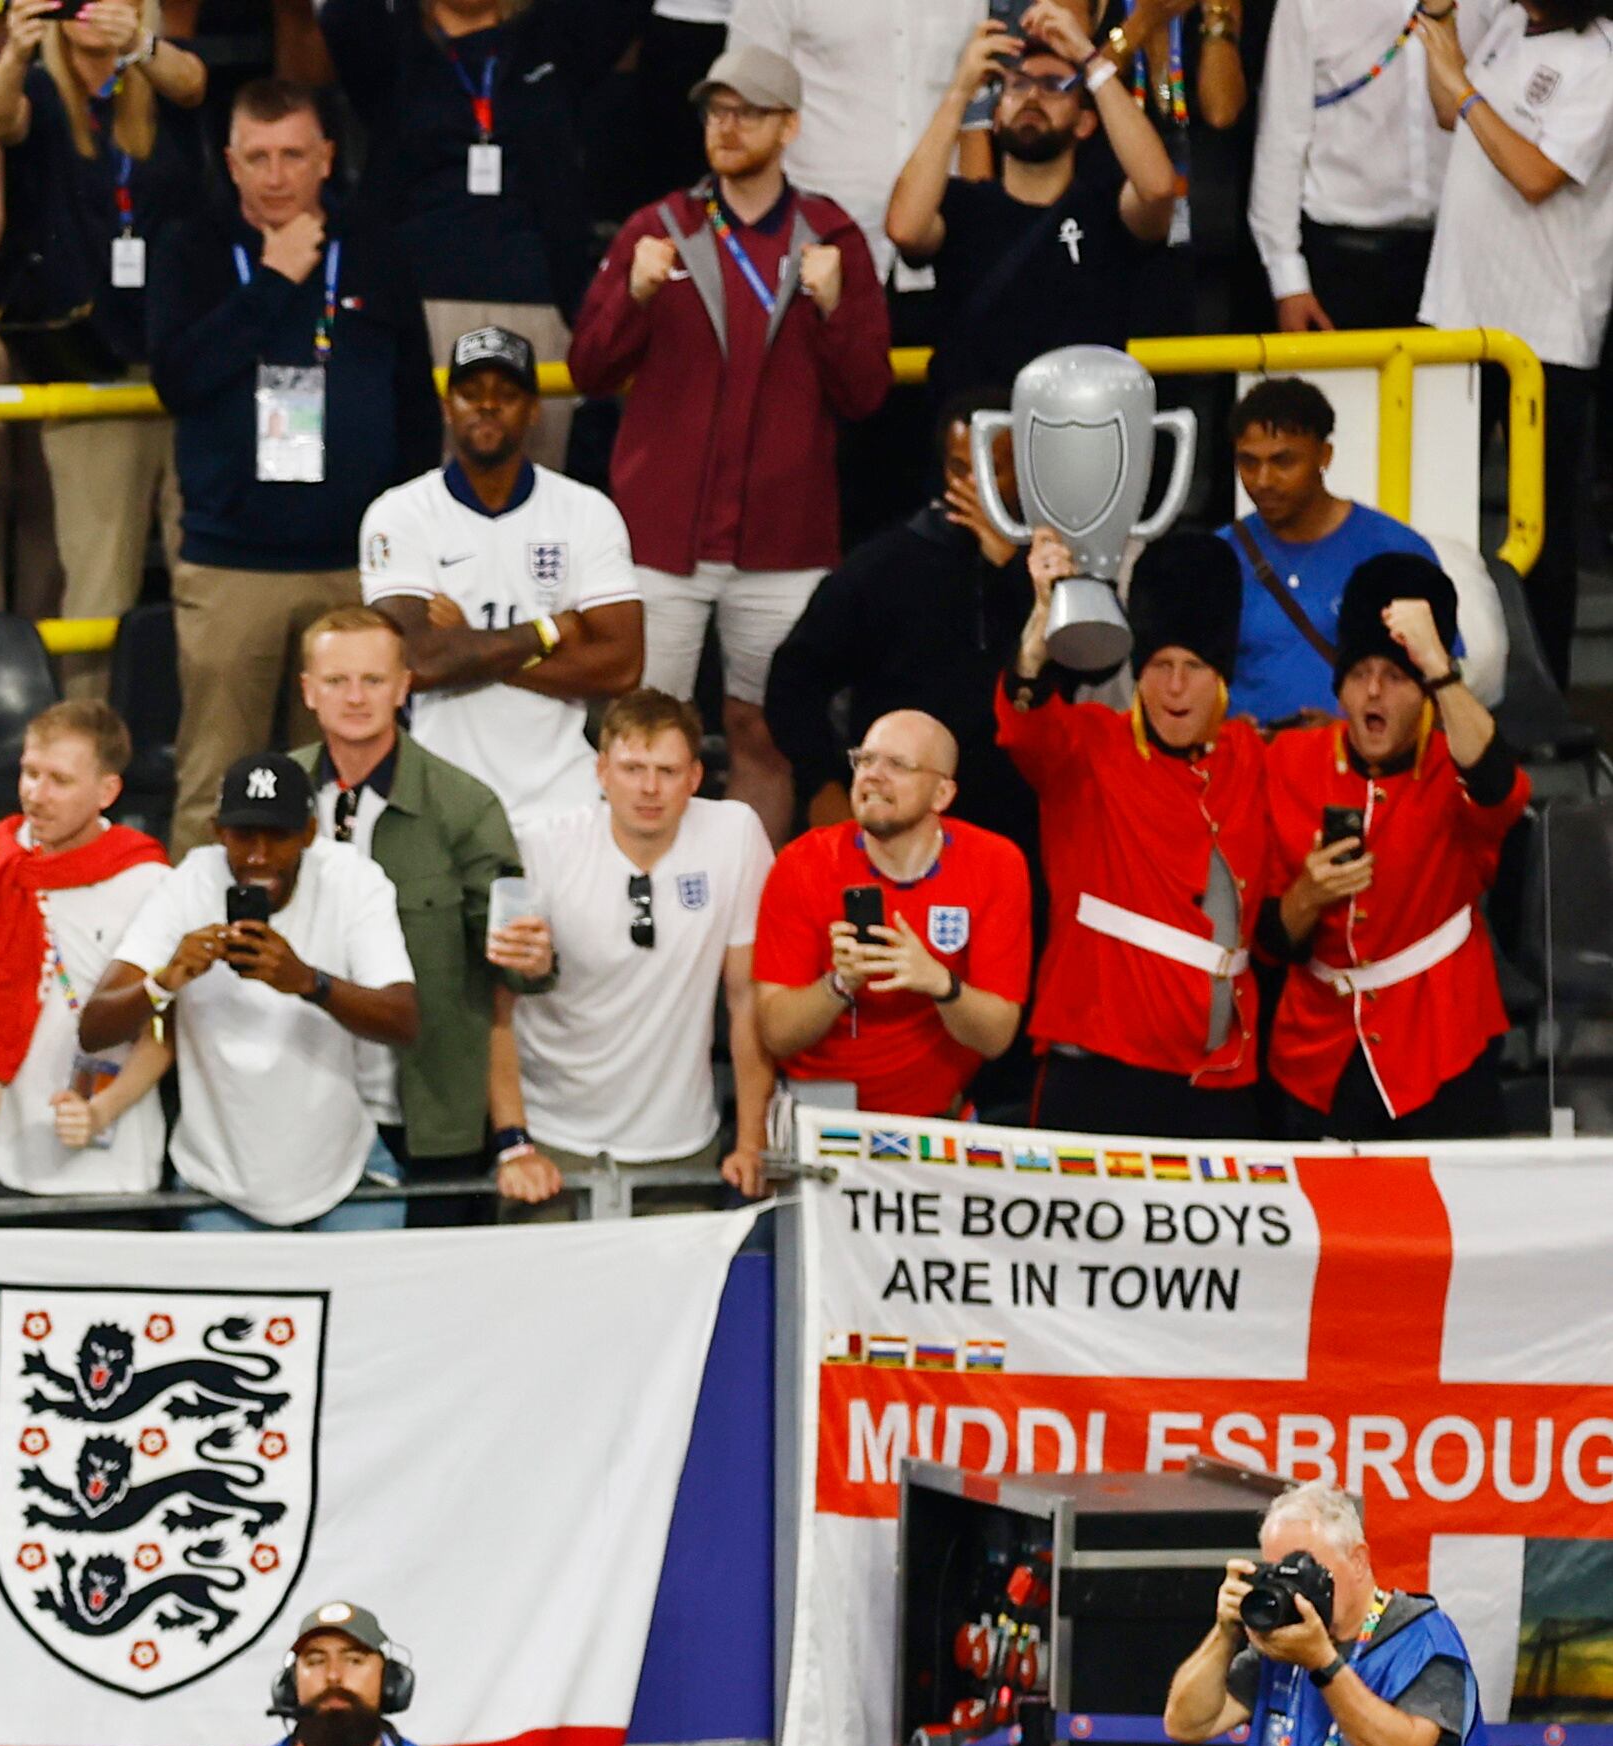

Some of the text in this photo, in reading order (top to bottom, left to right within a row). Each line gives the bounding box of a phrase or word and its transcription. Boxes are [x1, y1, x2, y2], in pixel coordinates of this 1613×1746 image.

[841, 1188, 1292, 1247] THE BORO BOYS
[881, 1257, 1240, 1311] ARE IN TOWN
